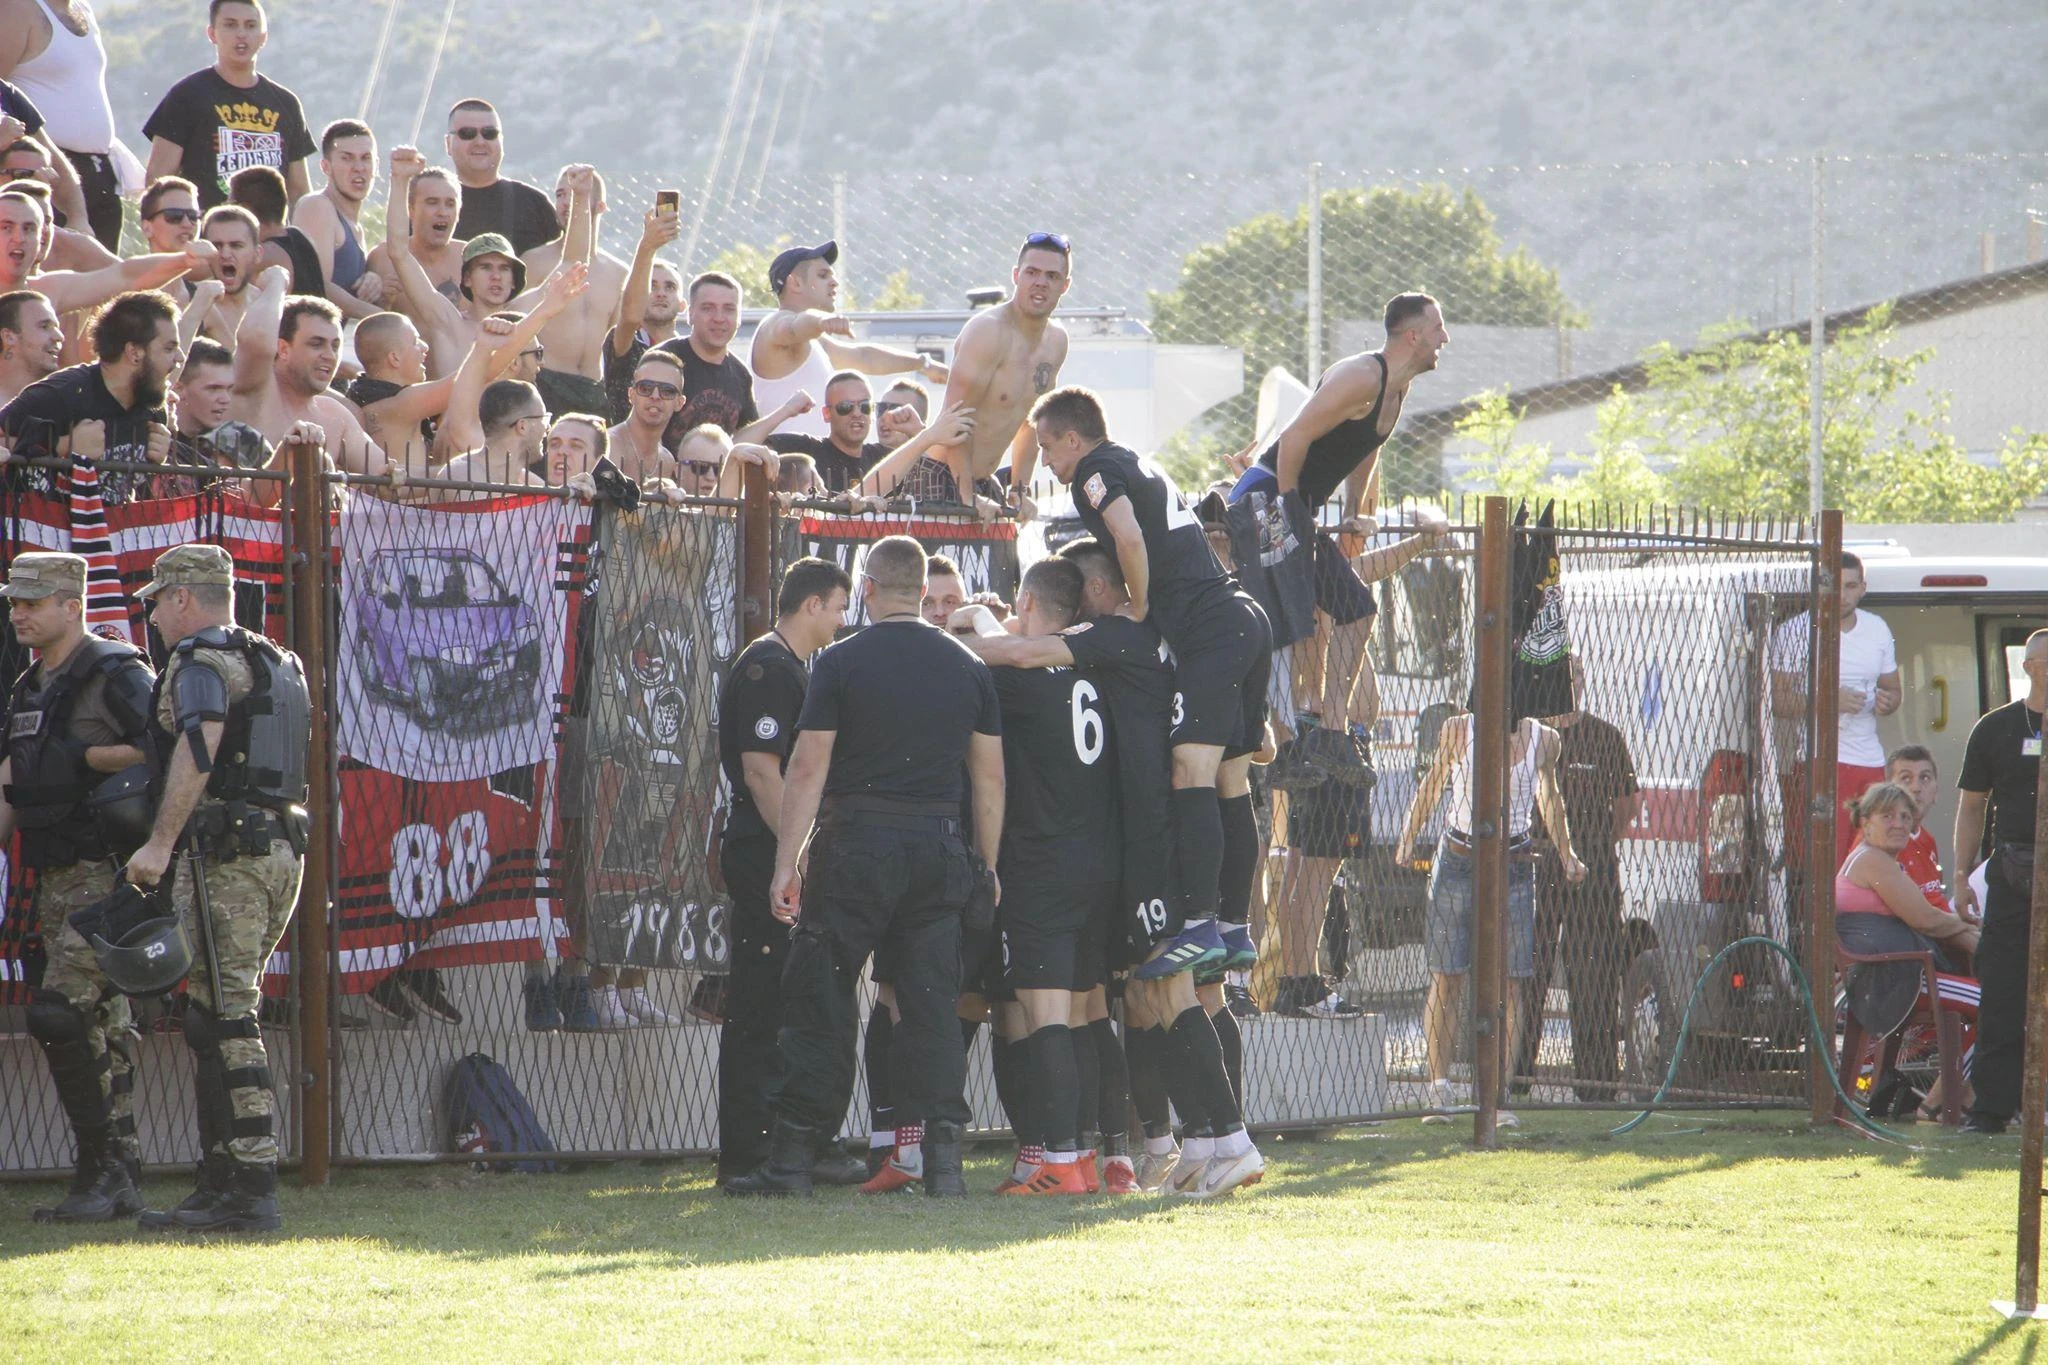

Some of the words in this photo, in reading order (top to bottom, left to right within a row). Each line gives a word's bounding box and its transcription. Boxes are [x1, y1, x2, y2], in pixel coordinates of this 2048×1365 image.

[1072, 679, 1104, 766] 6
[389, 810, 491, 919] 88
[620, 902, 728, 964] 1988
[1136, 898, 1167, 937] 19
